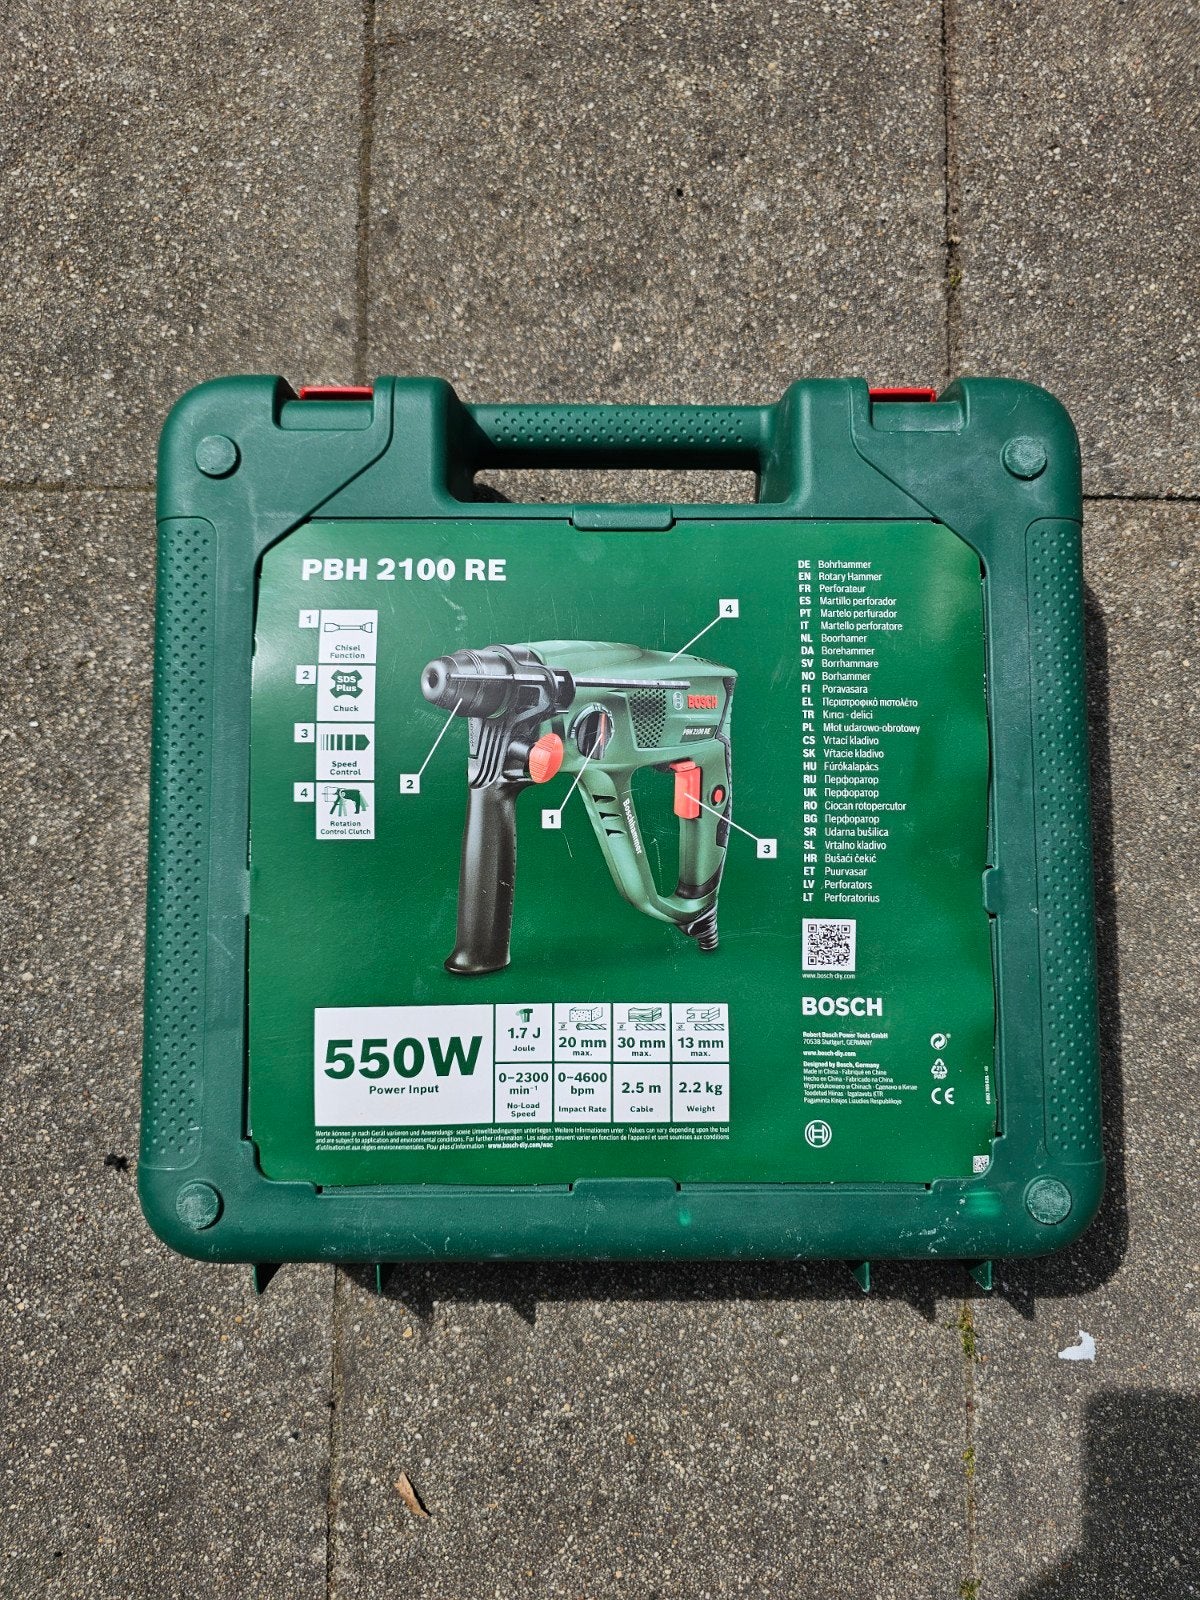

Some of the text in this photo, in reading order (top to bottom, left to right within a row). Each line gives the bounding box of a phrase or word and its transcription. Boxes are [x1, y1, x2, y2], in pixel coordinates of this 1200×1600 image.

[798, 560, 871, 569] DE Bohrhammer
[302, 559, 507, 581] PBH 2100 RE
[799, 572, 882, 582] EN Rotary Hammer
[799, 584, 866, 593] FR Perforateur
[800, 597, 897, 606] ES Martillo perforador
[724, 604, 733, 614] 4
[800, 609, 897, 619] PT Martelo perfurador
[306, 615, 312, 624] 1
[801, 621, 903, 631] IT Martello perforatore
[801, 634, 867, 643] NL Boorhamer
[801, 646, 875, 655] DA Borehammer
[330, 652, 366, 660] Function
[801, 659, 879, 668] SV Borrhammare
[302, 671, 310, 680] 2
[337, 675, 357, 684] SDS
[802, 672, 871, 681] NO Borhammer
[336, 684, 357, 692] Plus
[802, 685, 868, 694] FI Poravasara
[687, 694, 718, 709] BOSCH
[802, 697, 918, 708] EL Περιστροφικό πιστολέτο
[802, 710, 873, 719] TR Kırıcı delici
[301, 729, 309, 738] 3
[803, 723, 920, 735] PL Młot udarowo-obrotowy
[803, 736, 815, 745] CS
[850, 736, 879, 745] kladivo
[803, 749, 816, 758] SK
[855, 749, 885, 758] kladivo
[332, 761, 357, 769] Speed
[803, 762, 879, 773] HU Fúrókalapács
[406, 780, 414, 789] 2
[803, 775, 879, 785] RU Перфоратор
[301, 789, 308, 798] 4
[804, 788, 879, 798] UK Перфоратор
[804, 801, 907, 811] RO Ciocan rotopercutor
[548, 815, 555, 824] 1
[804, 814, 880, 825] BG Перфоратор
[347, 828, 371, 836] Clutch
[622, 799, 643, 855] Boschhammer
[804, 827, 889, 837] SR Udarna bušilica
[762, 845, 771, 854] 3
[804, 841, 887, 850] SL Vrtalno kladivo
[803, 854, 817, 863] HR
[803, 867, 867, 876] ET Puurvasar
[803, 880, 873, 889] LV Perforators
[803, 893, 880, 903] LT Perforatorius
[802, 997, 883, 1016] BOSCH
[508, 1027, 541, 1039] 1.7 J
[559, 1037, 607, 1048] 20 mm
[618, 1037, 666, 1048] 30 mm
[678, 1037, 724, 1048] 13 mm
[323, 1036, 484, 1080] 550W
[499, 1072, 549, 1083] 0–2300
[558, 1072, 607, 1083] 0–4600
[369, 1084, 440, 1095] Power Input
[571, 1086, 595, 1096] bpm
[622, 1082, 662, 1094] 2.5 m
[679, 1082, 723, 1095] 2.2 kg
[931, 1087, 955, 1105] CE
